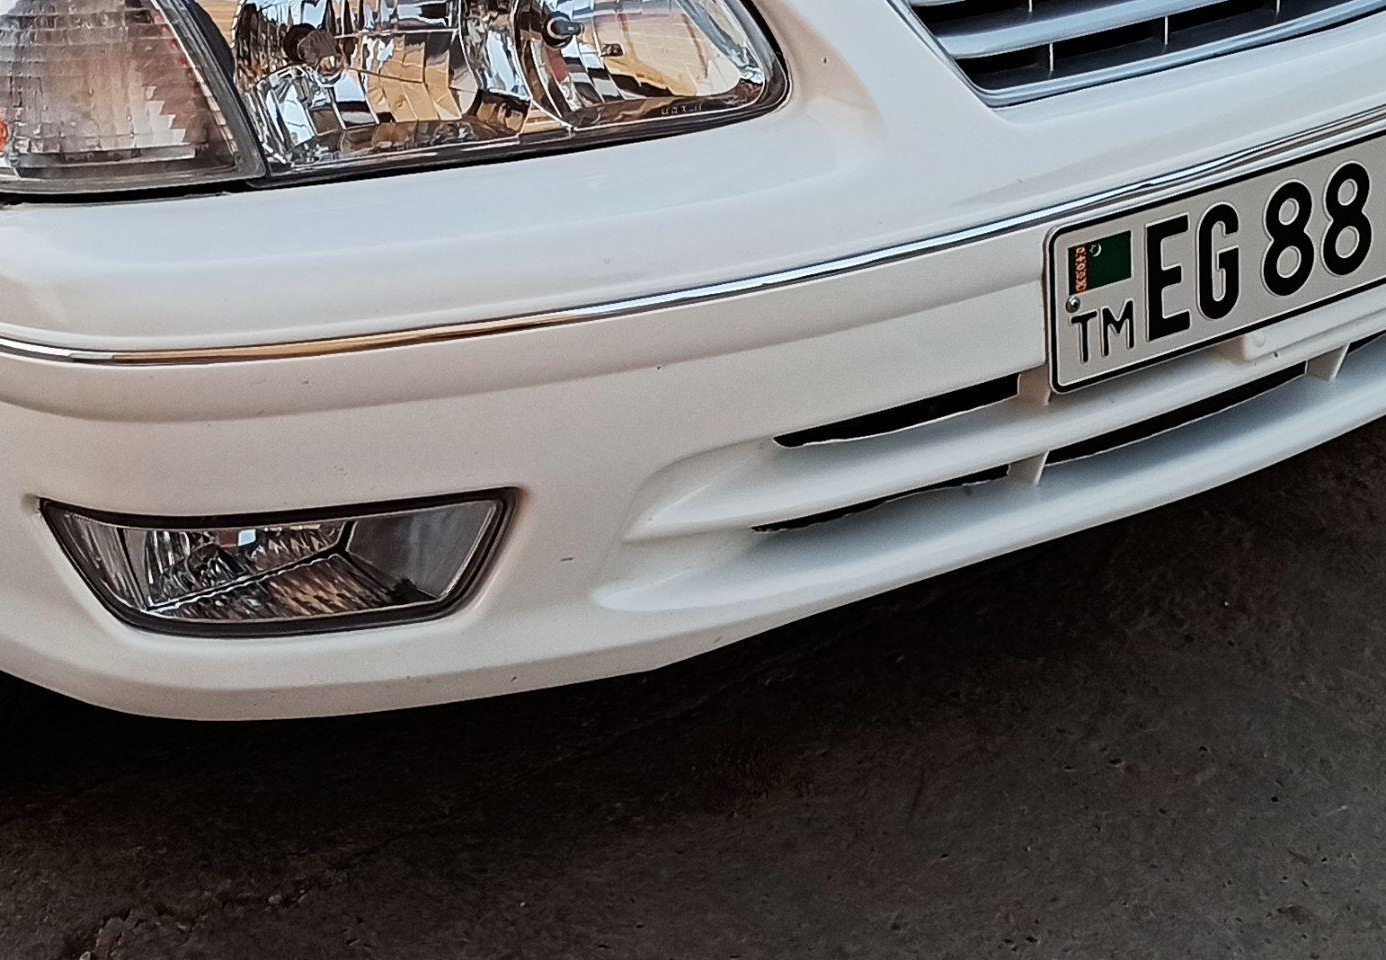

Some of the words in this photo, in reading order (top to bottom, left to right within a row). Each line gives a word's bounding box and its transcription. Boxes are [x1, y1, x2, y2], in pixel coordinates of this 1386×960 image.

[1146, 205, 1239, 341] EG
[1263, 162, 1372, 296] 88
[1070, 301, 1134, 364] TM
